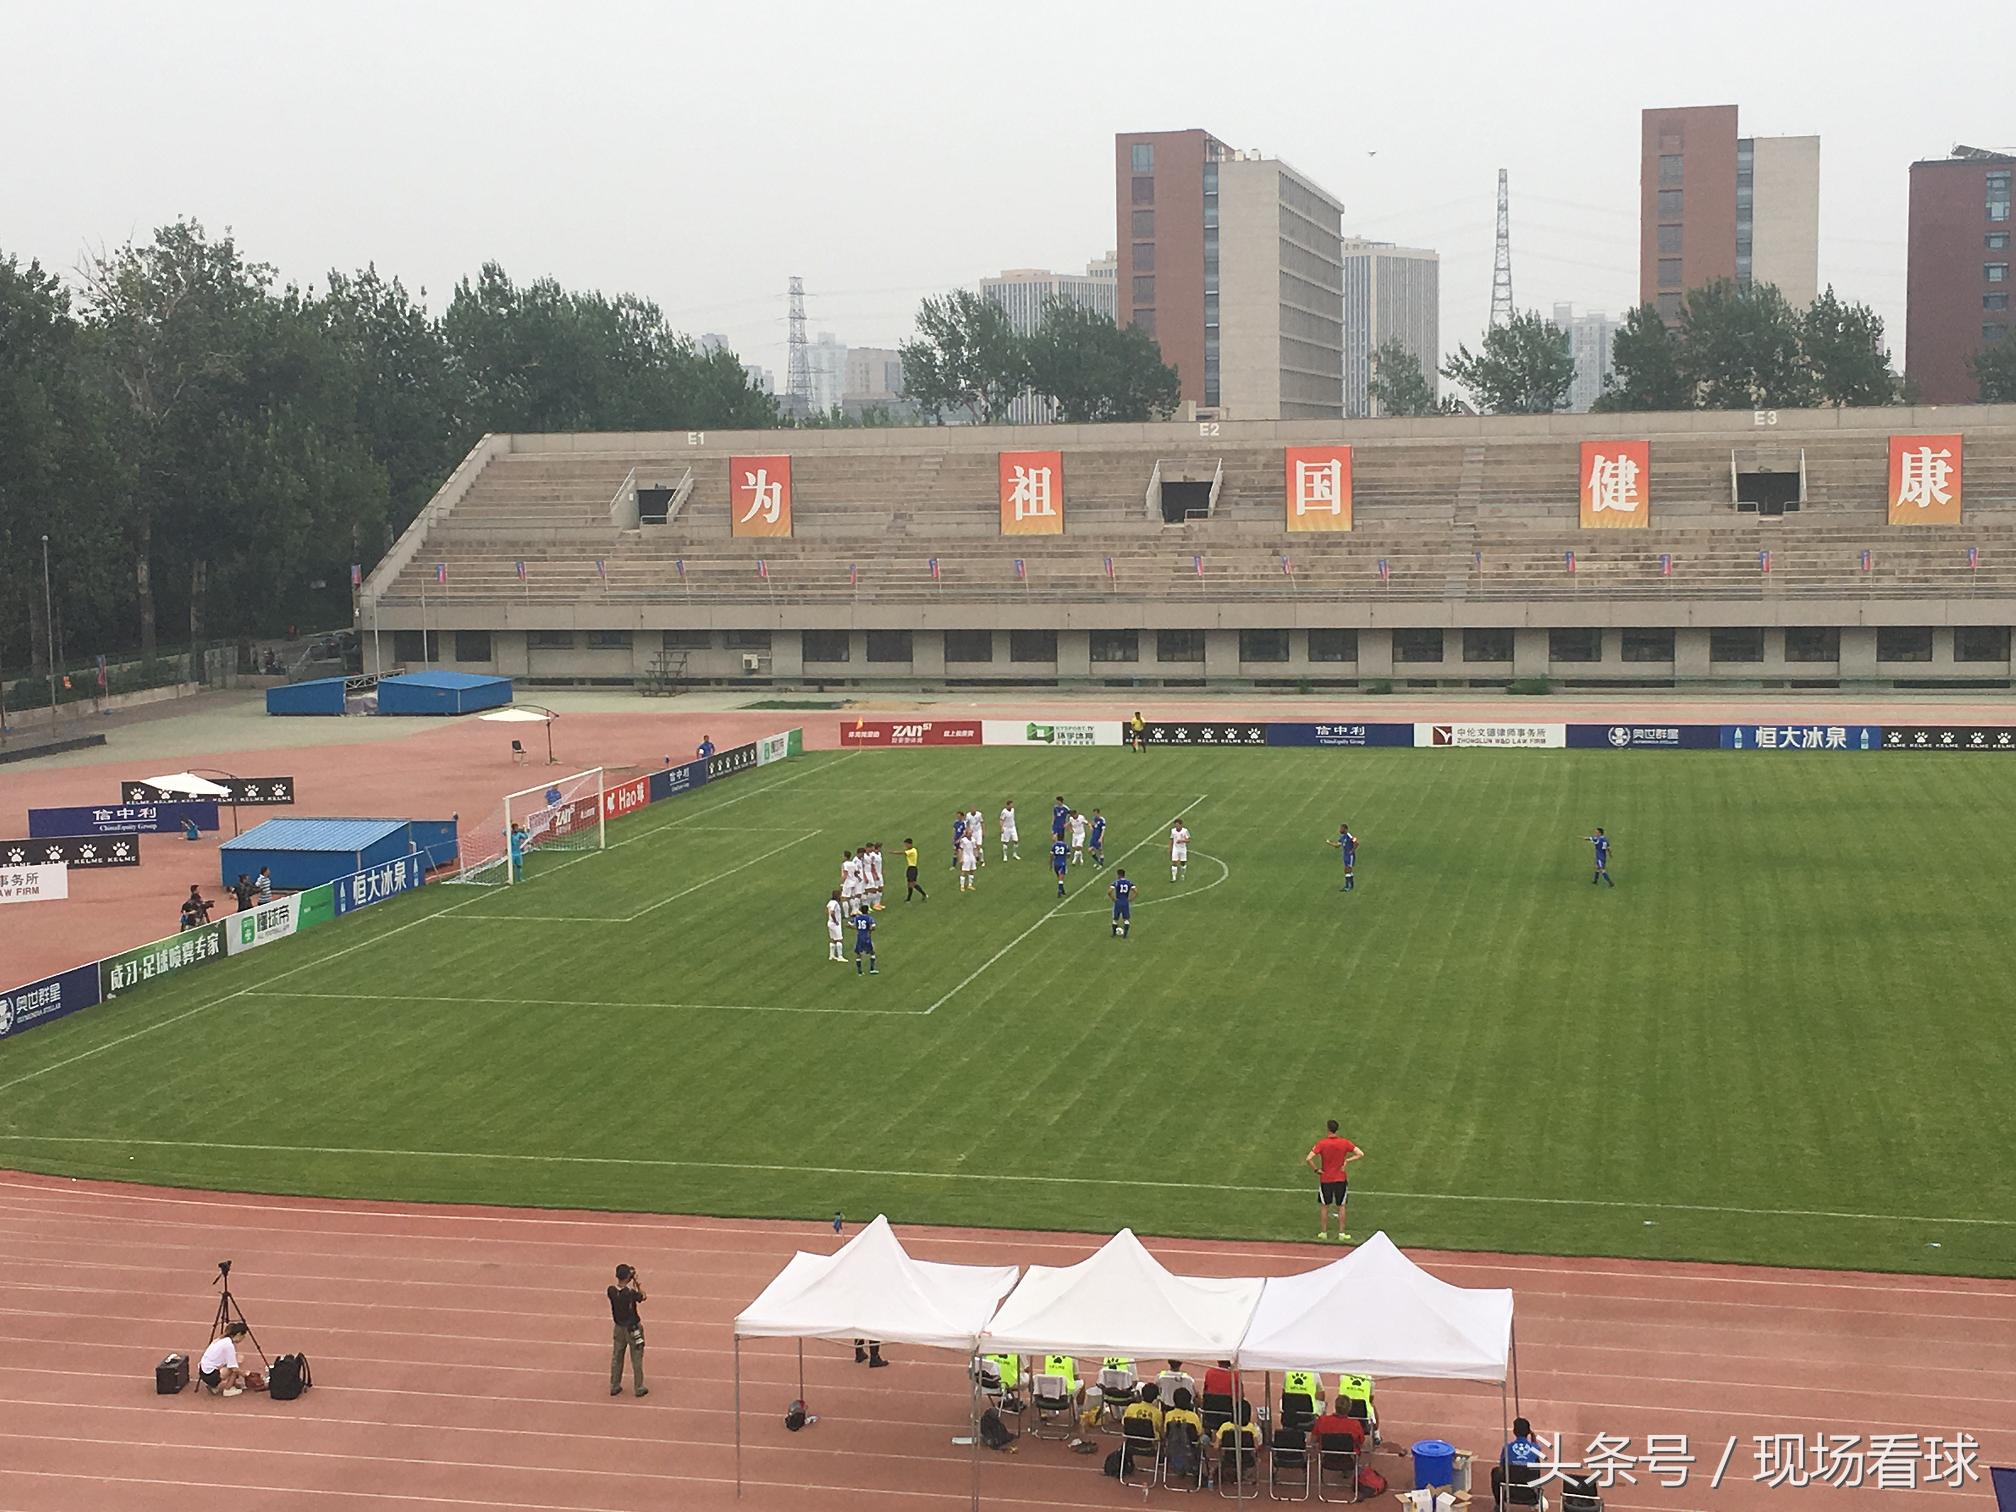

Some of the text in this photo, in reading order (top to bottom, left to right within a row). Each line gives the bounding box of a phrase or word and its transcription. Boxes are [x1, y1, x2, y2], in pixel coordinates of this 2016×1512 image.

[1753, 410, 1778, 425] E3
[687, 431, 705, 446] E1
[1199, 422, 1220, 437] E2
[1587, 454, 1640, 512] 健
[1896, 446, 1954, 507] 康
[740, 469, 783, 523] 为
[1008, 465, 1057, 521] 祖
[1295, 458, 1342, 515] 国
[1755, 726, 1848, 750] 恒大冰泉
[92, 807, 157, 821] 信中利
[107, 855, 136, 863] KELME
[1054, 845, 1065, 855] 23
[16, 886, 40, 896] FIRM
[352, 860, 407, 906] 恒大冰泉
[1119, 884, 1129, 893] 13
[16, 982, 61, 1015] 奥世群星
